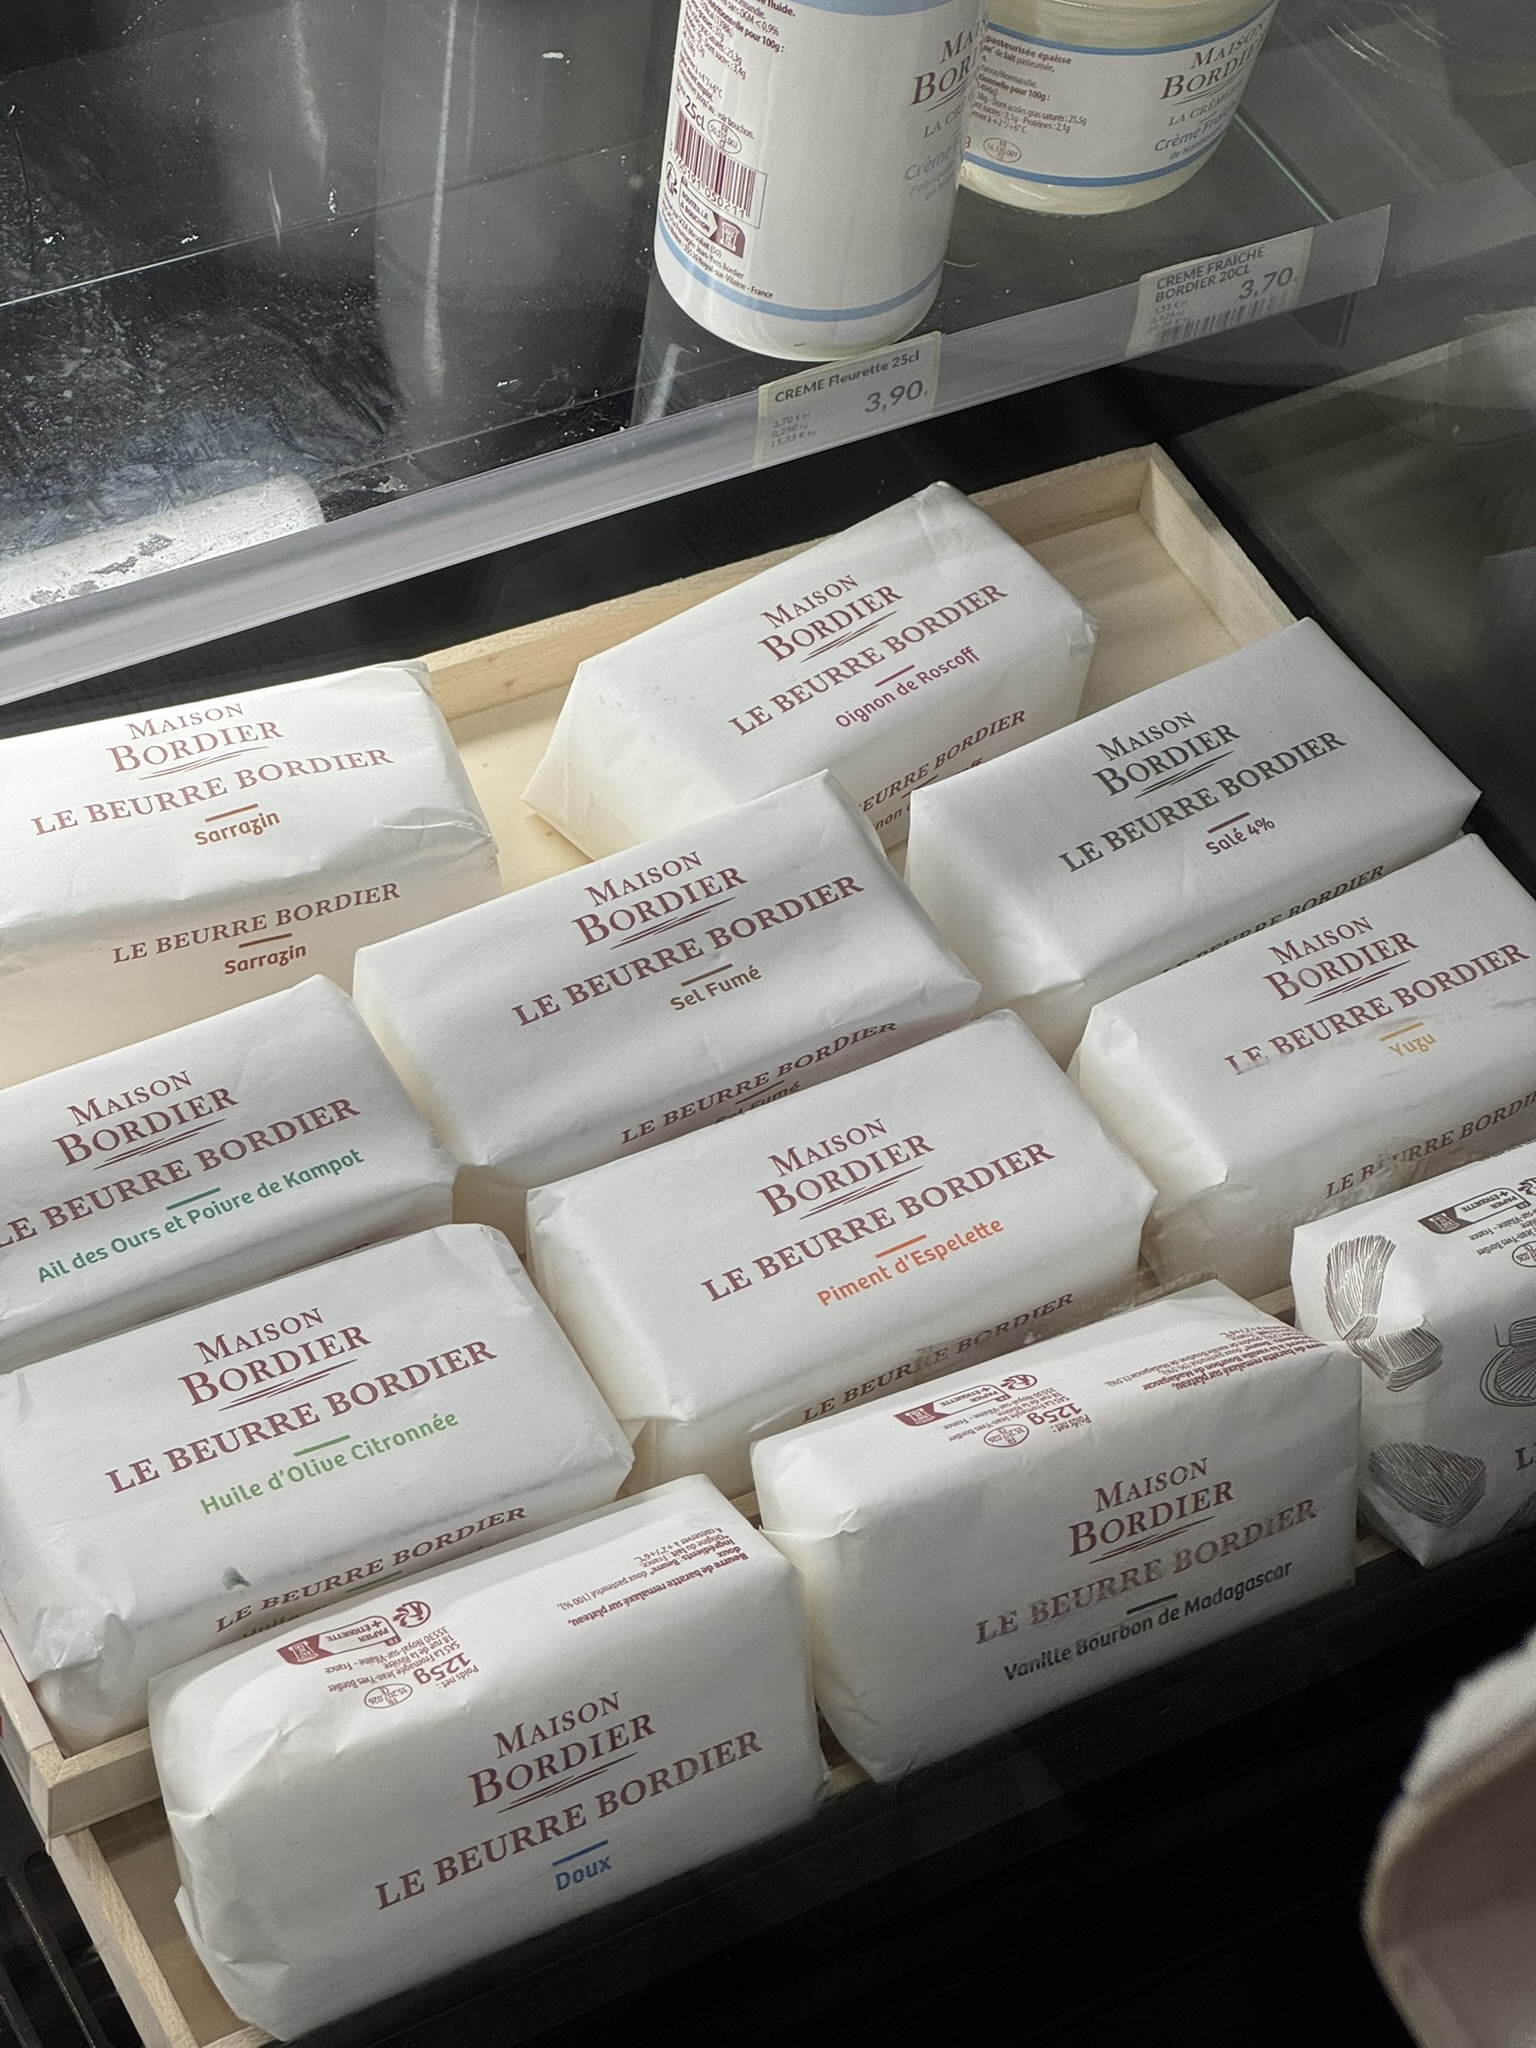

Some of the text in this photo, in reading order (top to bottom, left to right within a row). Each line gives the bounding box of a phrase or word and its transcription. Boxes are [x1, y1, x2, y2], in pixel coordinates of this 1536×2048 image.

[1037, 50, 1072, 65] épaisse
[684, 94, 705, 131] 25cl
[751, 285, 773, 299] France
[1155, 263, 1251, 303] BORDIER 20CL
[1156, 245, 1266, 290] CREME FRAICHE
[1238, 266, 1294, 300] 3,70
[775, 350, 920, 403] CREME Fleurette 25cl
[864, 380, 924, 413] 3,90
[758, 585, 903, 662] BORDIER
[761, 574, 858, 629] MAISON
[728, 584, 1008, 735] LE BEURRE BORDIER
[835, 645, 980, 728] Oignon de Roscoff
[106, 721, 284, 773] BORDIER
[126, 703, 245, 740] MAISON
[1096, 711, 1196, 762] MAISON
[859, 710, 1026, 812] EURRE BORDIER
[1092, 723, 1241, 796] BORDIER
[31, 748, 394, 836] LE BEURRE BORDIER
[1058, 732, 1347, 872] LE BEURRE BORDIER
[194, 809, 280, 845] Sarrazin
[1205, 816, 1276, 855] Salé 4%
[572, 867, 748, 946] BORDIER
[584, 851, 703, 907] MAISON
[112, 882, 400, 963] LE BEURRE BORDIER
[511, 875, 864, 1026] LE BEURRE BORDIER
[1268, 916, 1374, 966] MAISON
[224, 944, 307, 974] Sarrazin
[670, 964, 762, 1011] Sel Fumé
[1262, 931, 1419, 1000] BORDIER
[1224, 943, 1530, 1076] LE BEURRE BORDIER
[1388, 1032, 1437, 1057] Yuzu
[66, 1070, 192, 1127] MAISON
[621, 1021, 897, 1144] LE BEURRE BORDIER
[52, 1087, 239, 1166] BORDIER
[767, 1118, 888, 1177] MAISON
[40, 1098, 361, 1230] BEURRE BORDIER
[757, 1134, 935, 1217] BORDIER
[1326, 1172, 1354, 1199] LE
[37, 1148, 365, 1283] Ail des Ours et Poivre de Kampot
[701, 1142, 1055, 1301] LE BEURRE BORDIER
[816, 1218, 1004, 1307] Piment d'Espelette
[193, 1307, 325, 1365] MAISON
[802, 1398, 835, 1423] LE
[955, 1293, 1074, 1355] BORDIER
[177, 1325, 371, 1406] BORDIER
[105, 1341, 497, 1494] LE BEURRE BORDIER
[1026, 1403, 1082, 1426] 125g
[1069, 1413, 1092, 1428] Poids
[199, 1412, 459, 1515] Huile d'Olive Citronnée
[1095, 1457, 1208, 1513] MAISON
[1069, 1480, 1234, 1557] BORDIER
[215, 1605, 253, 1632] LE
[261, 1558, 384, 1610] BEURRE
[392, 1507, 528, 1567] BORDIER
[682, 1538, 735, 1562] Ingrédients
[976, 1499, 1317, 1644] LE BEURRE BORDIER
[567, 1551, 748, 1627] Beurre baratte remalaxé sur plateau,
[325, 1623, 371, 1642] ÉTIQUETTE
[358, 1627, 389, 1642] PAPIER
[1004, 1561, 1293, 1681] Vanille Bourbon de Madagascar
[324, 1626, 450, 1675] 35530 Noyal-sur-Vilaine France
[327, 1640, 460, 1692] SAS La Fromagée Jean-Yves Bordier
[383, 1633, 454, 1671] 18 rue Rivière
[413, 1652, 472, 1685] 125g
[442, 1664, 479, 1688] Poids net
[493, 1691, 620, 1759] MAISON
[468, 1713, 656, 1808] BORDIER
[374, 1730, 763, 1910] LE BEURRE BORDIER
[555, 1854, 613, 1891] Doux
